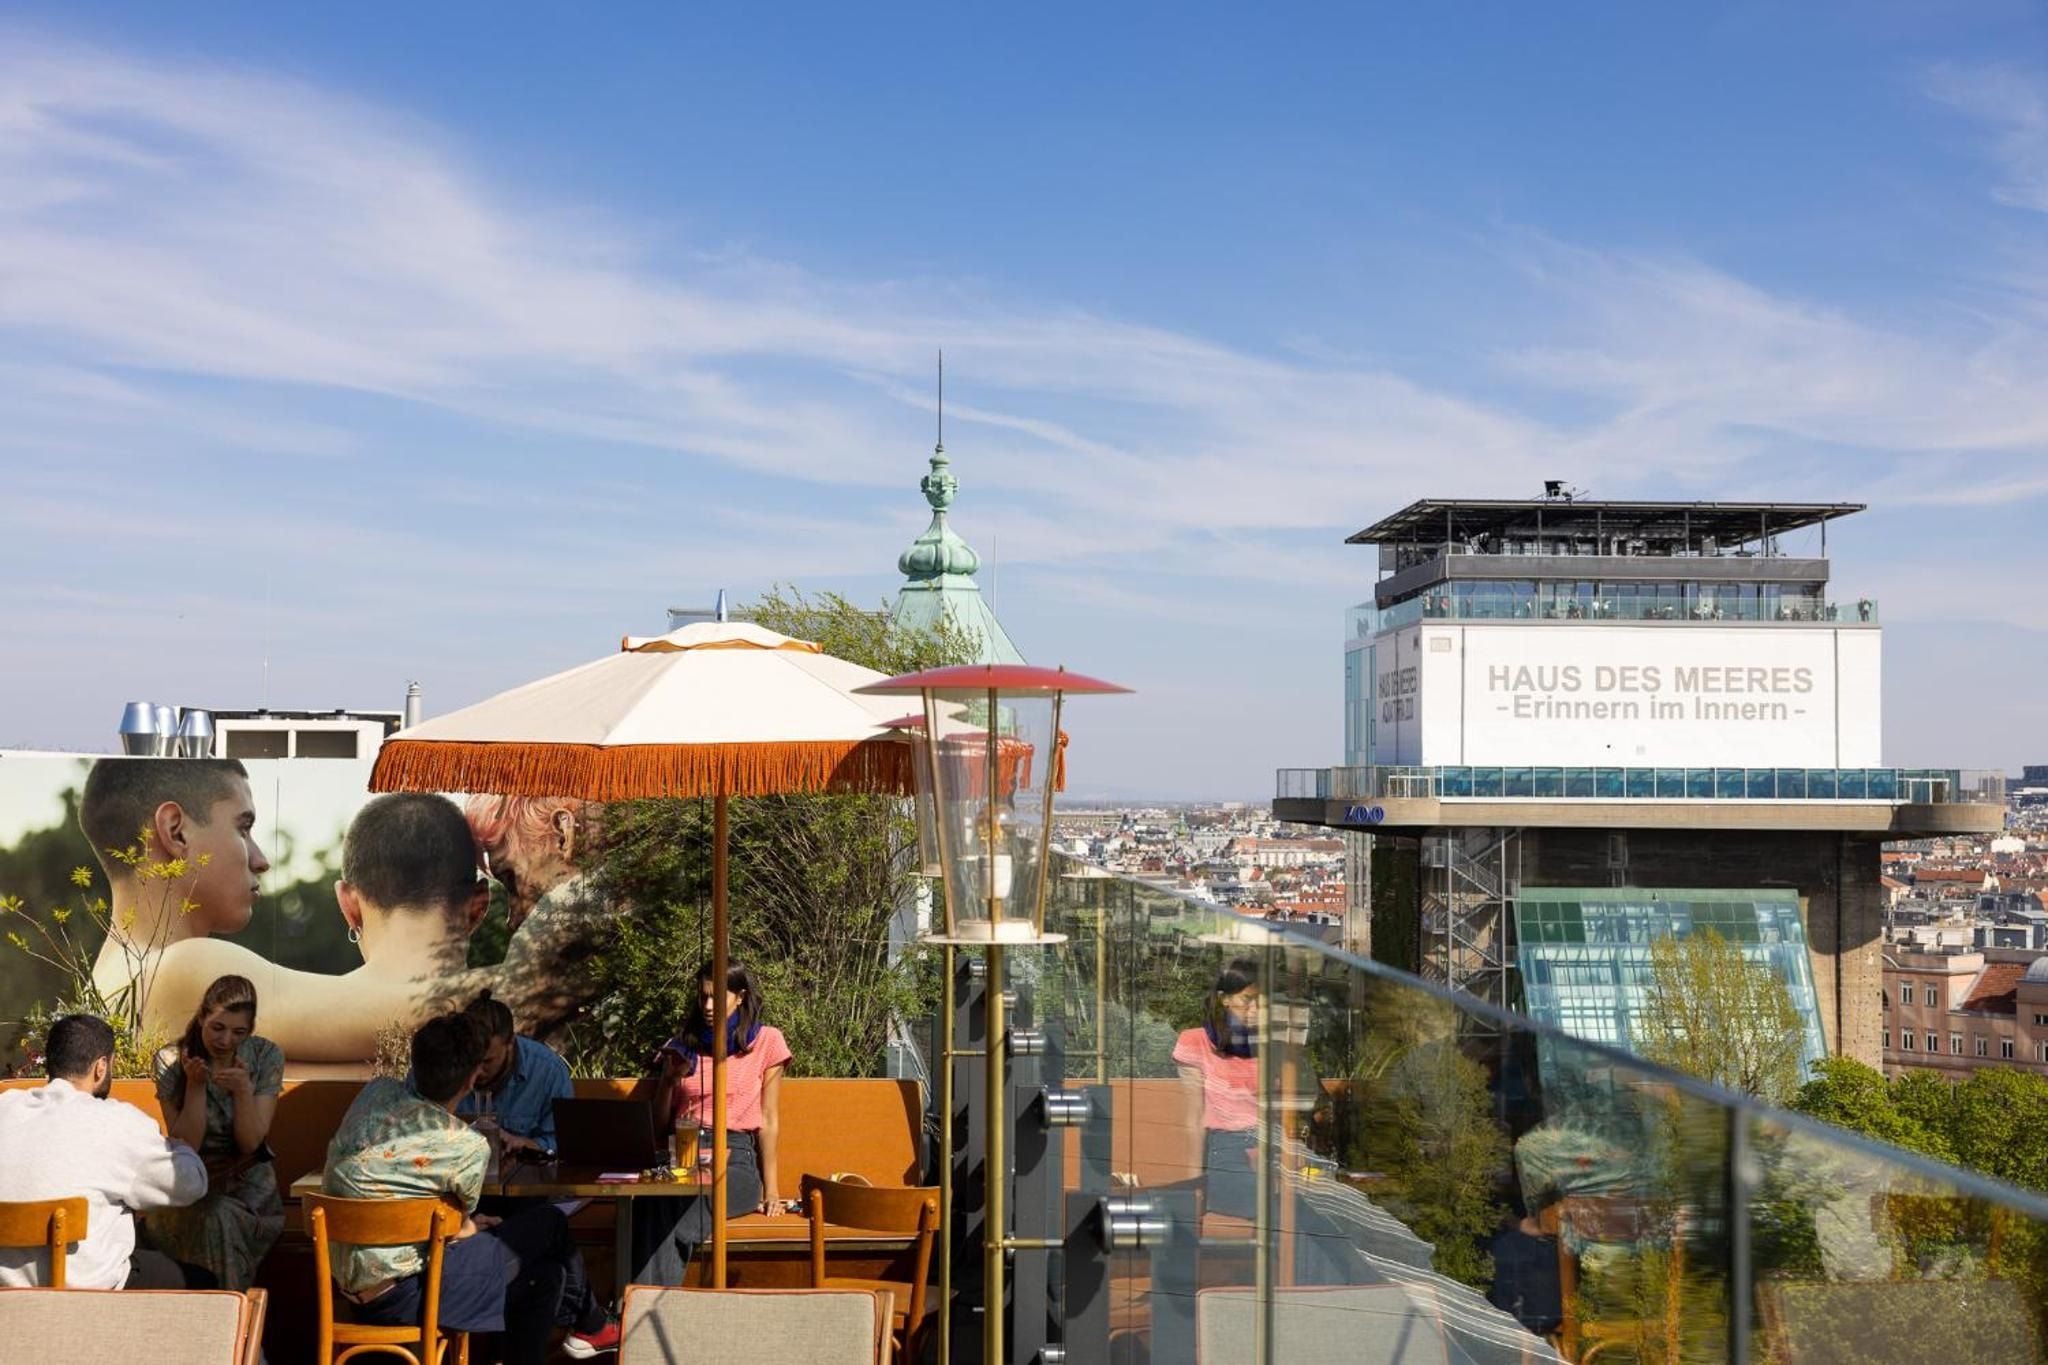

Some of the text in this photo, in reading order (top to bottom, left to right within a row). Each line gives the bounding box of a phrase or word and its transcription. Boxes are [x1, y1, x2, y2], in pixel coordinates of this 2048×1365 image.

[1488, 665, 1814, 693] HAUS DES MEERES
[1650, 694, 1684, 719] im
[1344, 806, 1384, 822] ZOO
